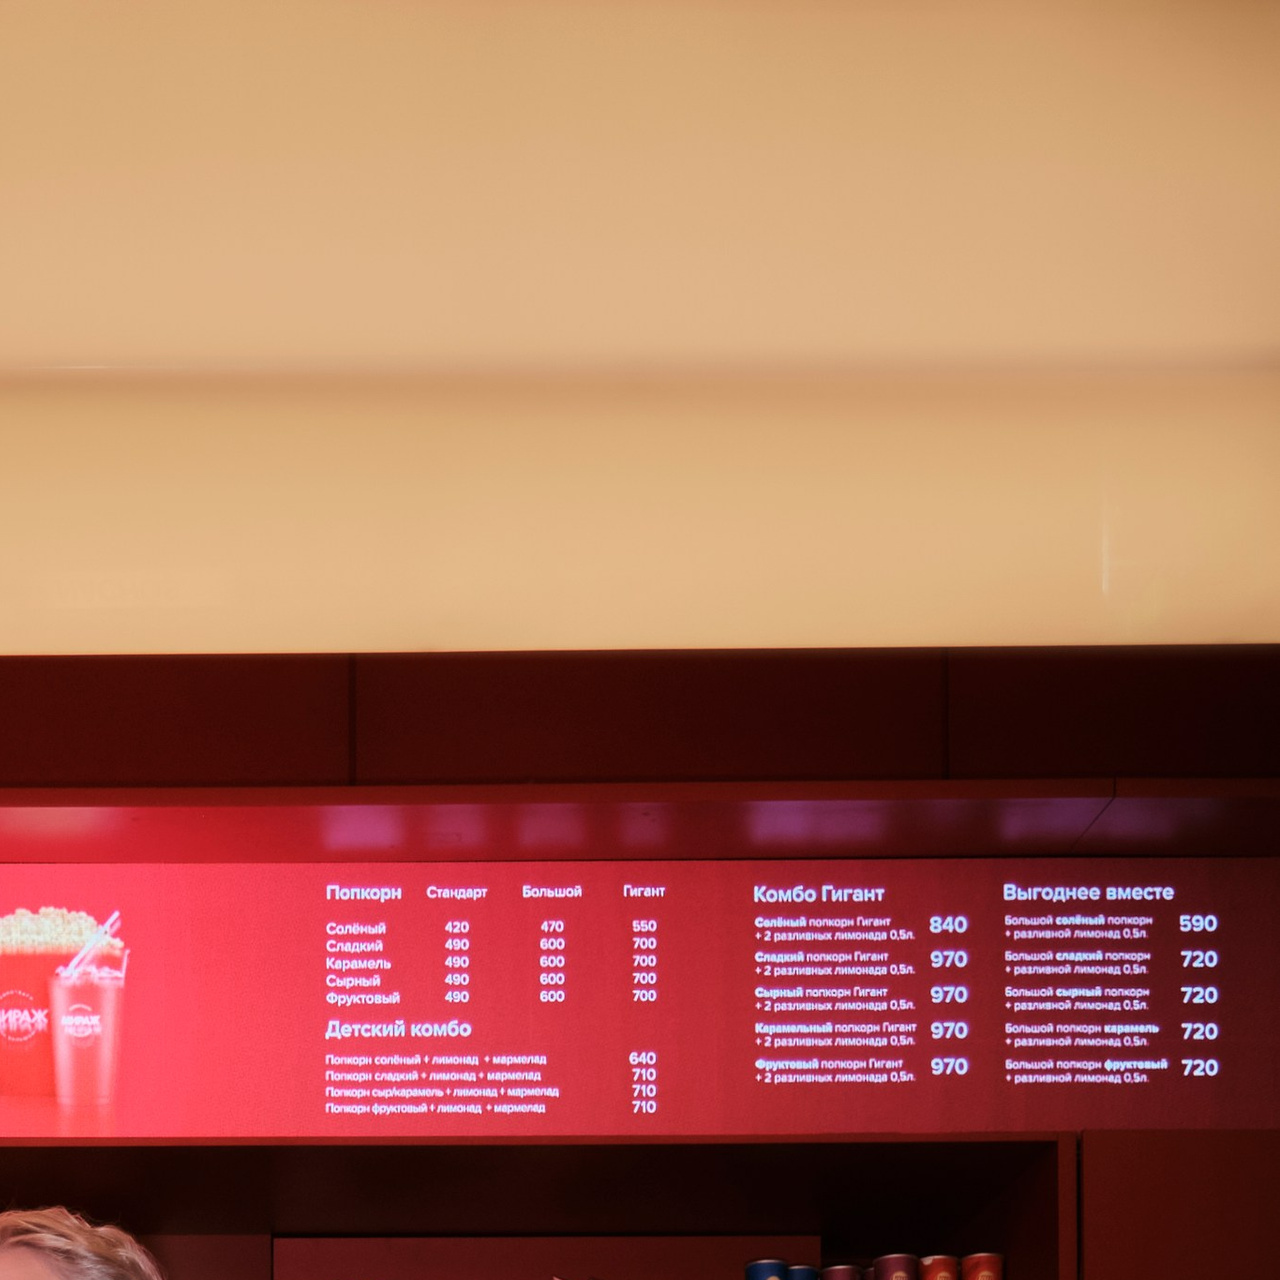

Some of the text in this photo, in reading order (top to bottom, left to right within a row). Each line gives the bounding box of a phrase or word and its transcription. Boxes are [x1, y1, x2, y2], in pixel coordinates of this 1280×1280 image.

[326, 884, 666, 903] Попкорн Стандарт Большой Гигант
[753, 884, 885, 903] Комбо Гигант
[1003, 883, 1175, 903] Выгоднее вместе
[325, 919, 658, 936] Солёный 420 470 550
[754, 916, 891, 928] Солёный попкорн Гигант
[929, 916, 968, 934] 840
[1004, 950, 1151, 962] Большой сладкий попкорн
[1180, 950, 1218, 968] 720
[325, 989, 657, 1007] Фруктовый 490 600 700
[324, 1019, 472, 1040] Детский комбо
